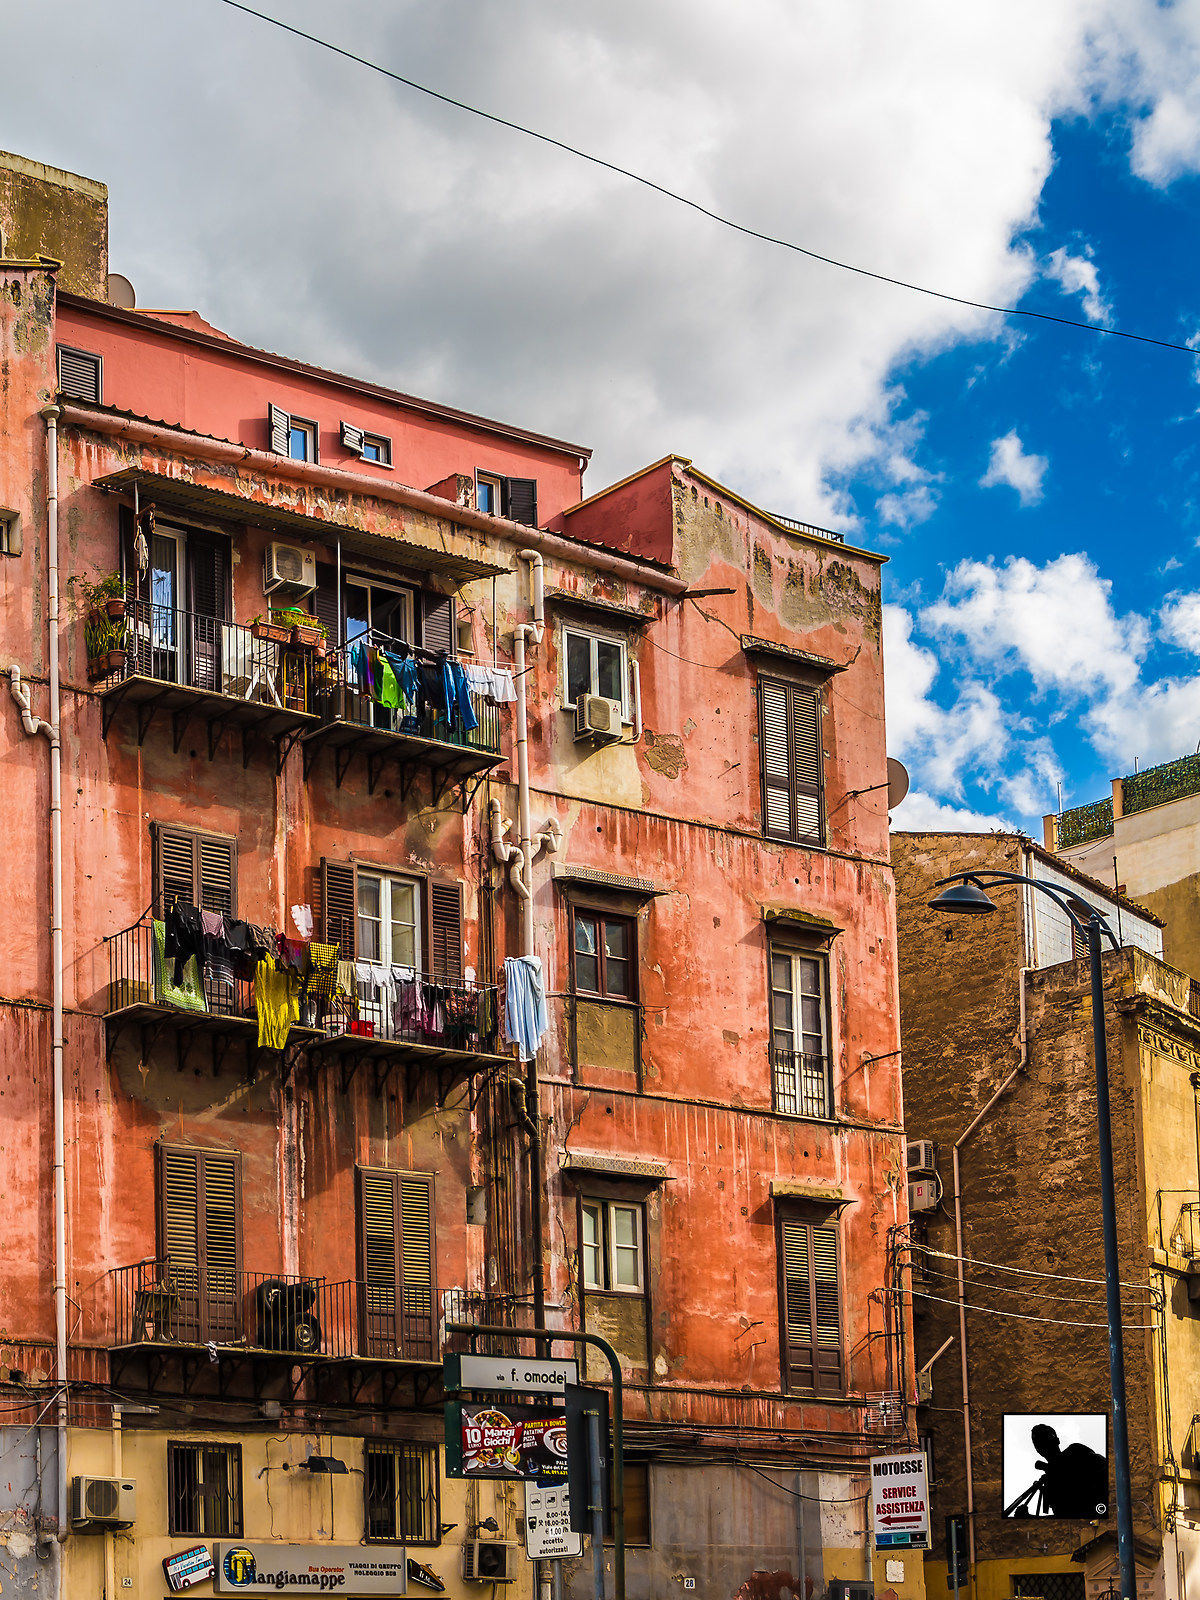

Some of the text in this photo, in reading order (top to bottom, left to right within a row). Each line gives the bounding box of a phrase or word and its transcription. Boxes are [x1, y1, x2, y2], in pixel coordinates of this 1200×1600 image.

[510, 1368, 519, 1382] f.
[524, 1370, 567, 1384] omodei
[464, 1428, 516, 1444] 10 Mangi
[483, 1436, 511, 1447] Giochi
[873, 1460, 922, 1476] MOTOESSE
[882, 1485, 917, 1500] SERVICE
[875, 1500, 925, 1515] ASSISTENZA
[539, 1546, 568, 1554] autorizzati
[308, 1565, 345, 1574] Bus Operator
[685, 1579, 694, 1588] 28
